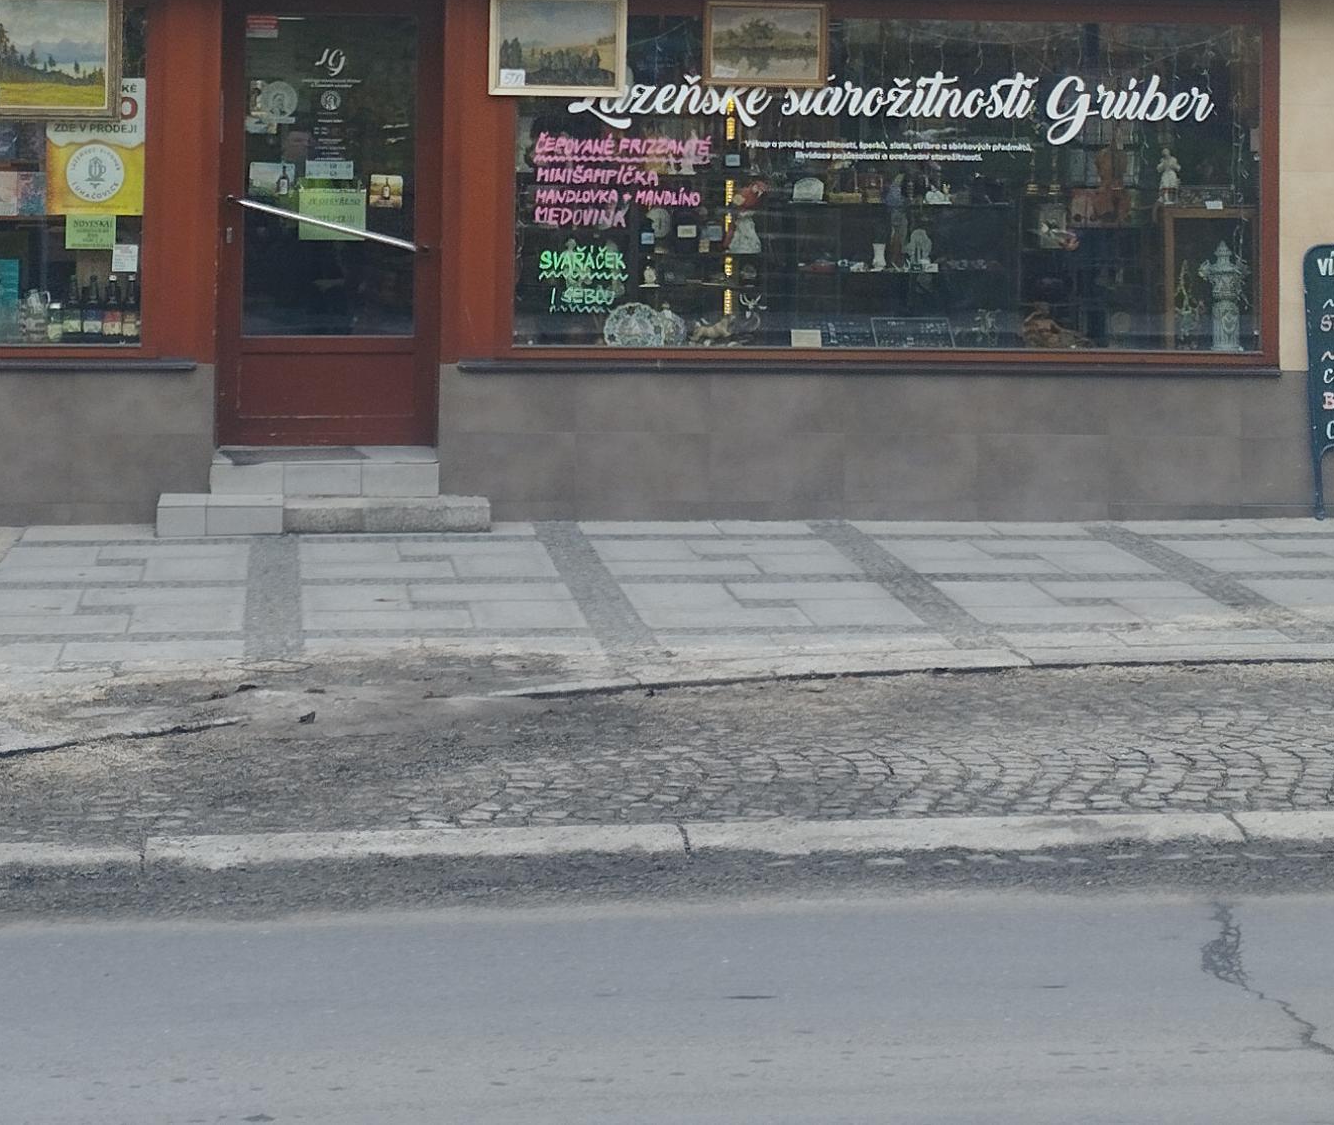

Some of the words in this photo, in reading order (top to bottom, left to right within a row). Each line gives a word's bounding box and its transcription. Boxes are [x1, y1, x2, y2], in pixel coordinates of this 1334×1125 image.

[54, 123, 76, 133] ZDE
[79, 123, 87, 133] V
[89, 123, 138, 134] PRODEJI
[535, 132, 615, 156] ČEPOVANÉ
